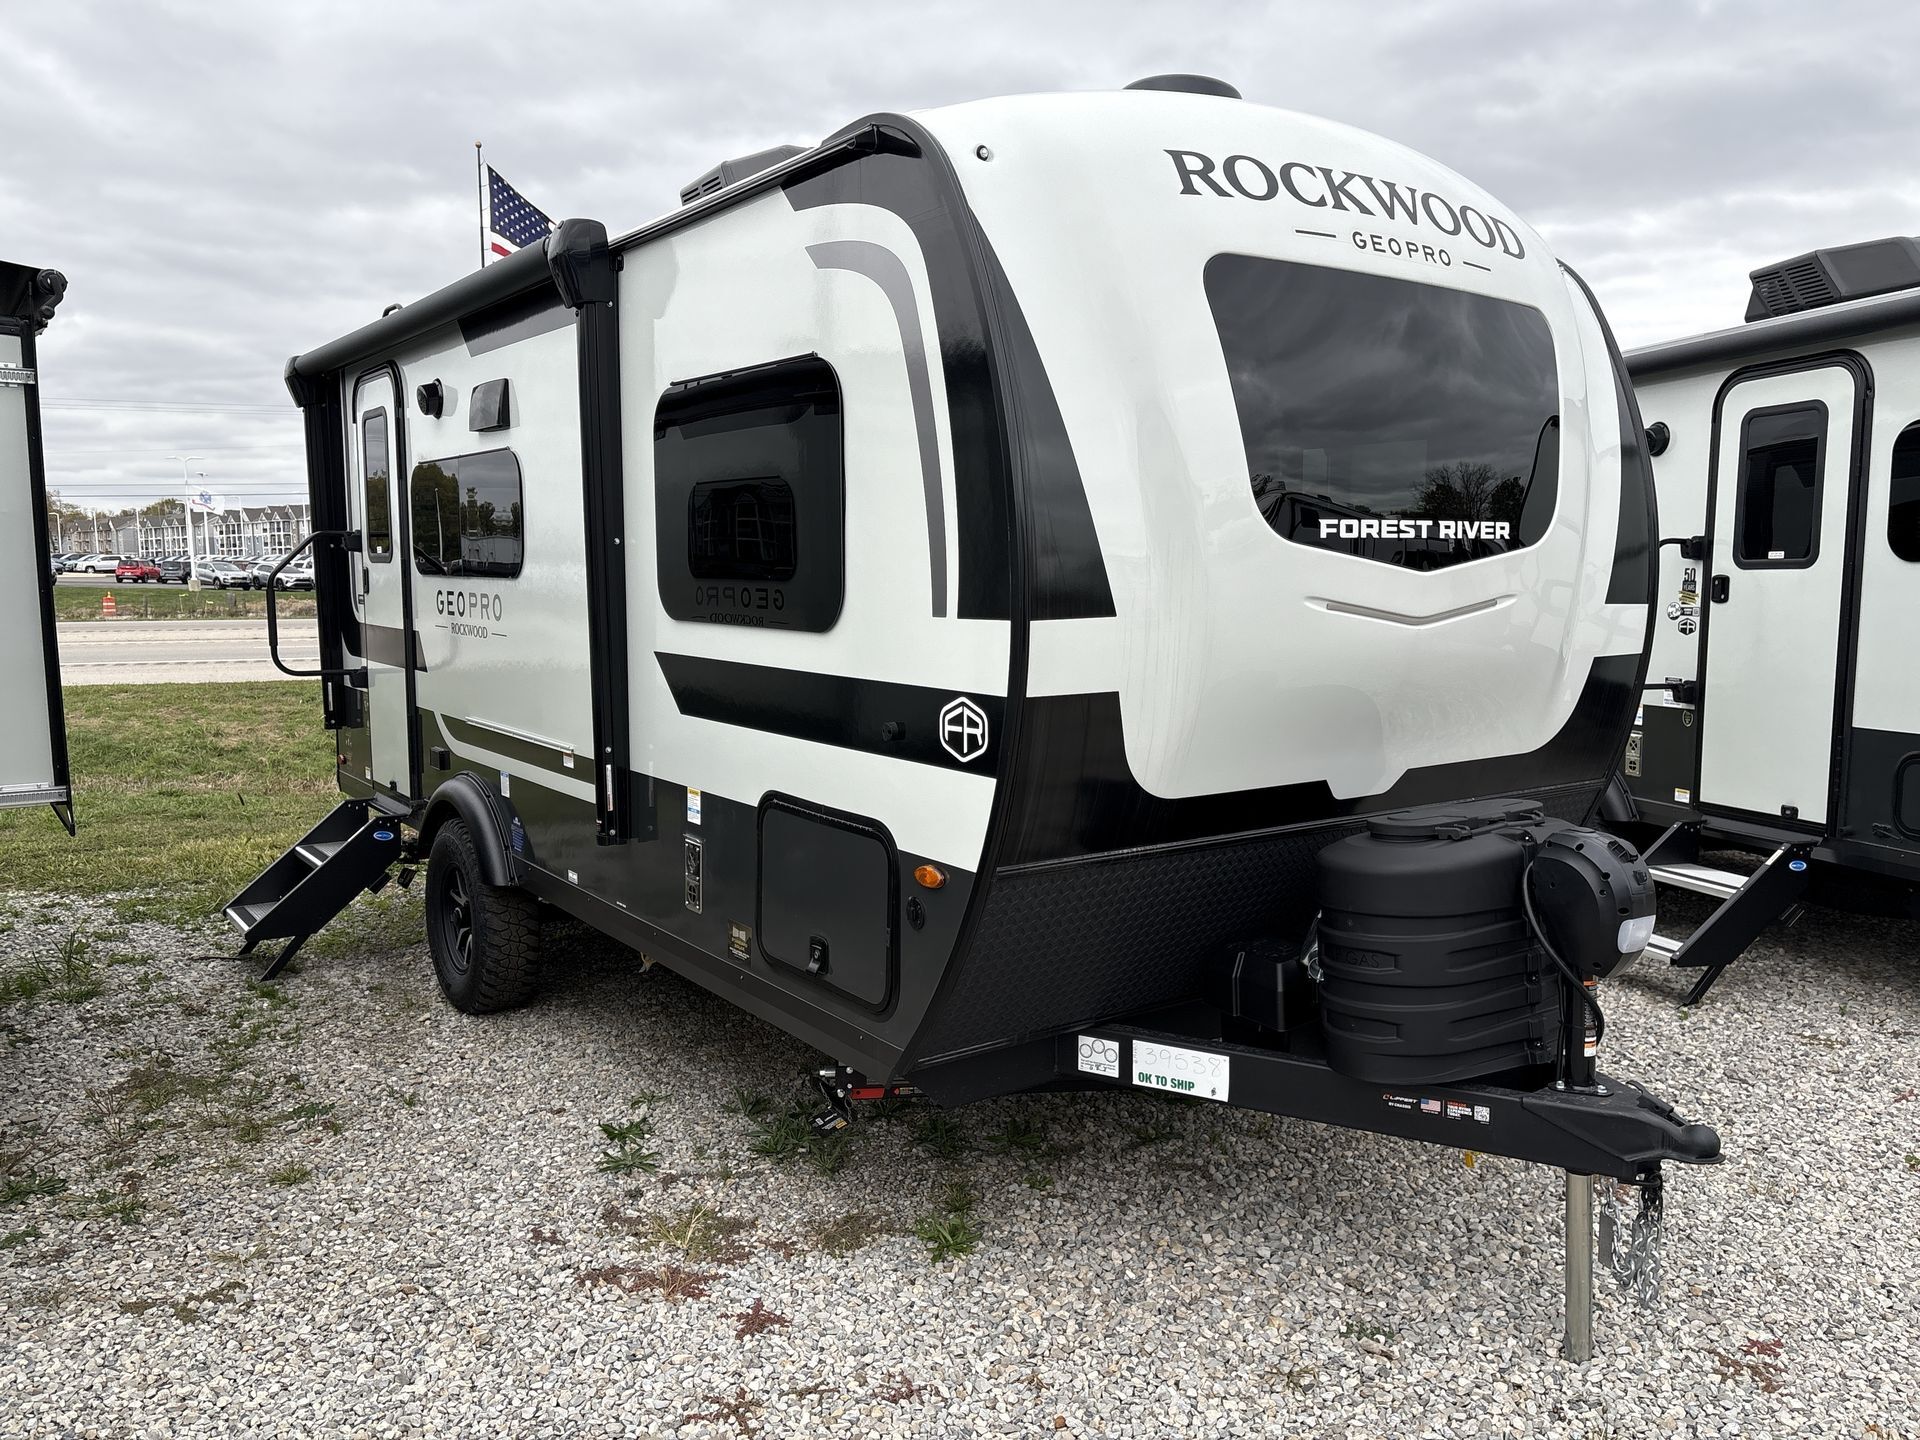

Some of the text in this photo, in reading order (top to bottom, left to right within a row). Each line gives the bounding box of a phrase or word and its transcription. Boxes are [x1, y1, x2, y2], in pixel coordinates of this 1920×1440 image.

[1163, 149, 1526, 260] ROCKWOOD
[1352, 231, 1452, 267] GEOPRO
[1318, 518, 1510, 540] FOREST RIVER
[1684, 567, 1696, 582] 50
[436, 589, 502, 621] GEOPRO
[451, 622, 488, 639] ROCKWOOD
[1138, 1071, 1195, 1092] OK TO SHIP
